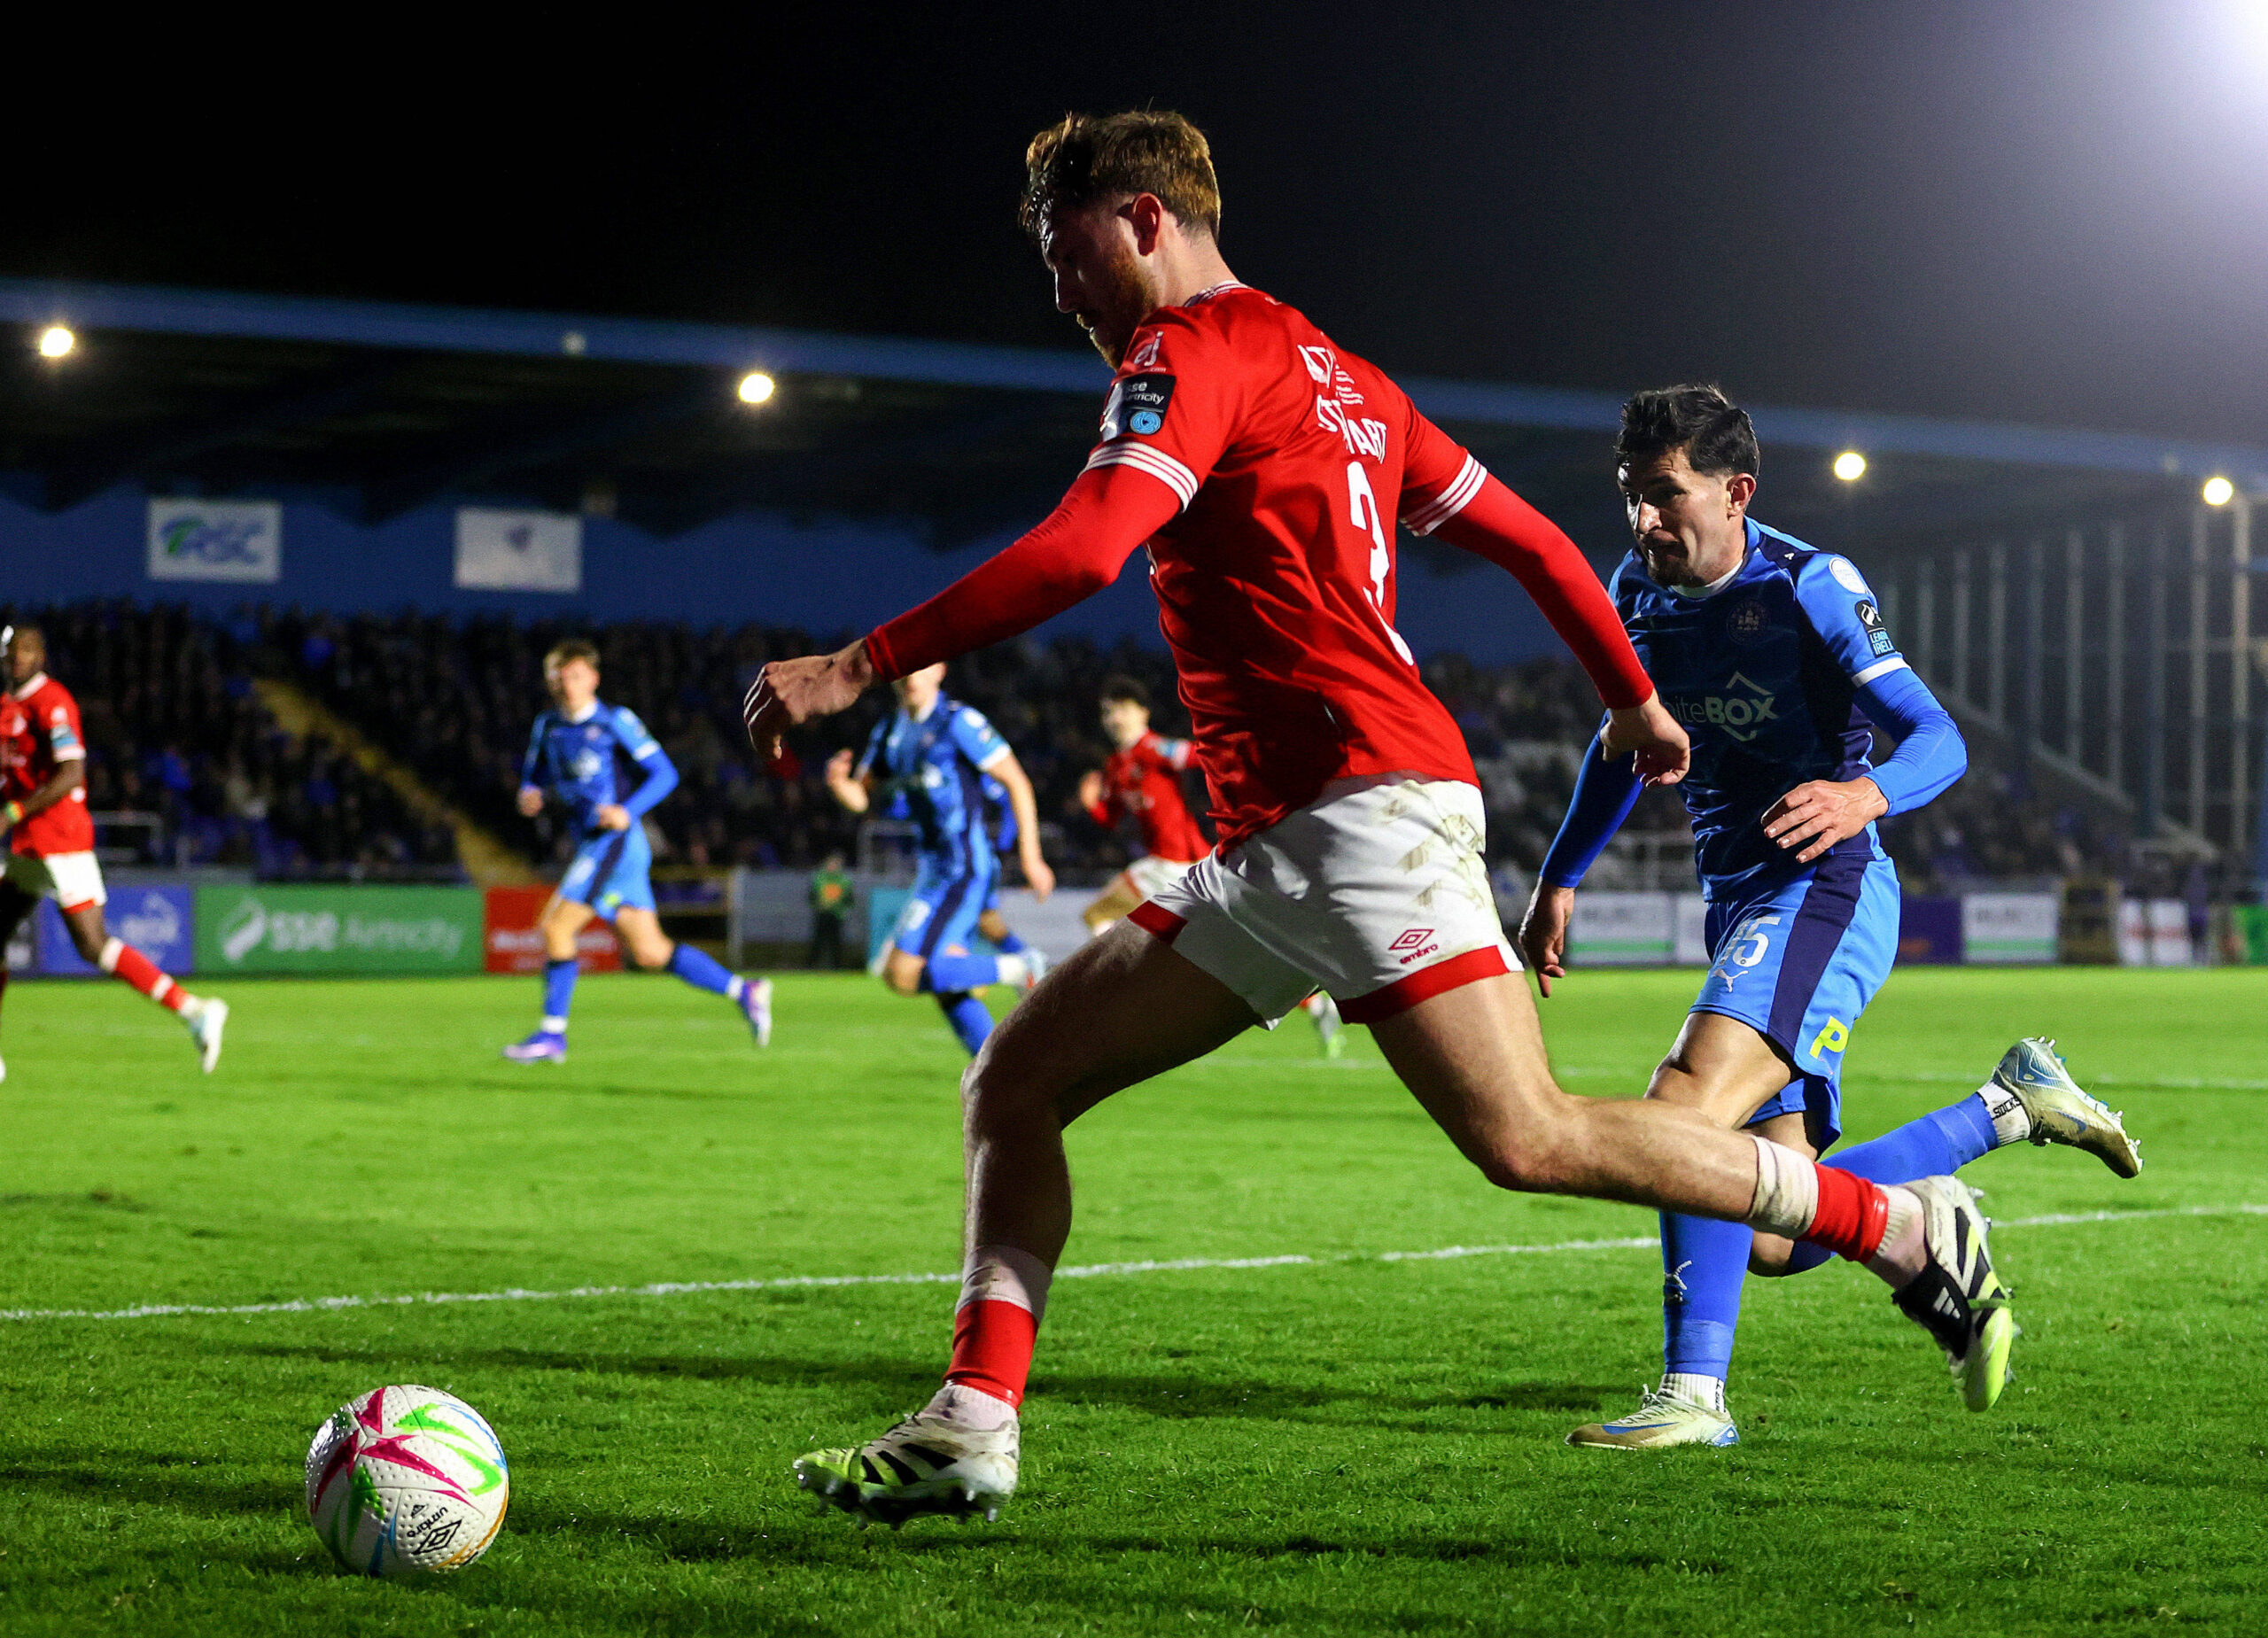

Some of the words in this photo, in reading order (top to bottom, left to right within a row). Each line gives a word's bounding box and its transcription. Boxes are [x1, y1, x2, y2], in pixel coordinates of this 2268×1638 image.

[1317, 394, 1387, 464] START
[1347, 461, 1415, 666] 3
[1400, 943, 1438, 965] umbro
[407, 1507, 448, 1537] umbro
